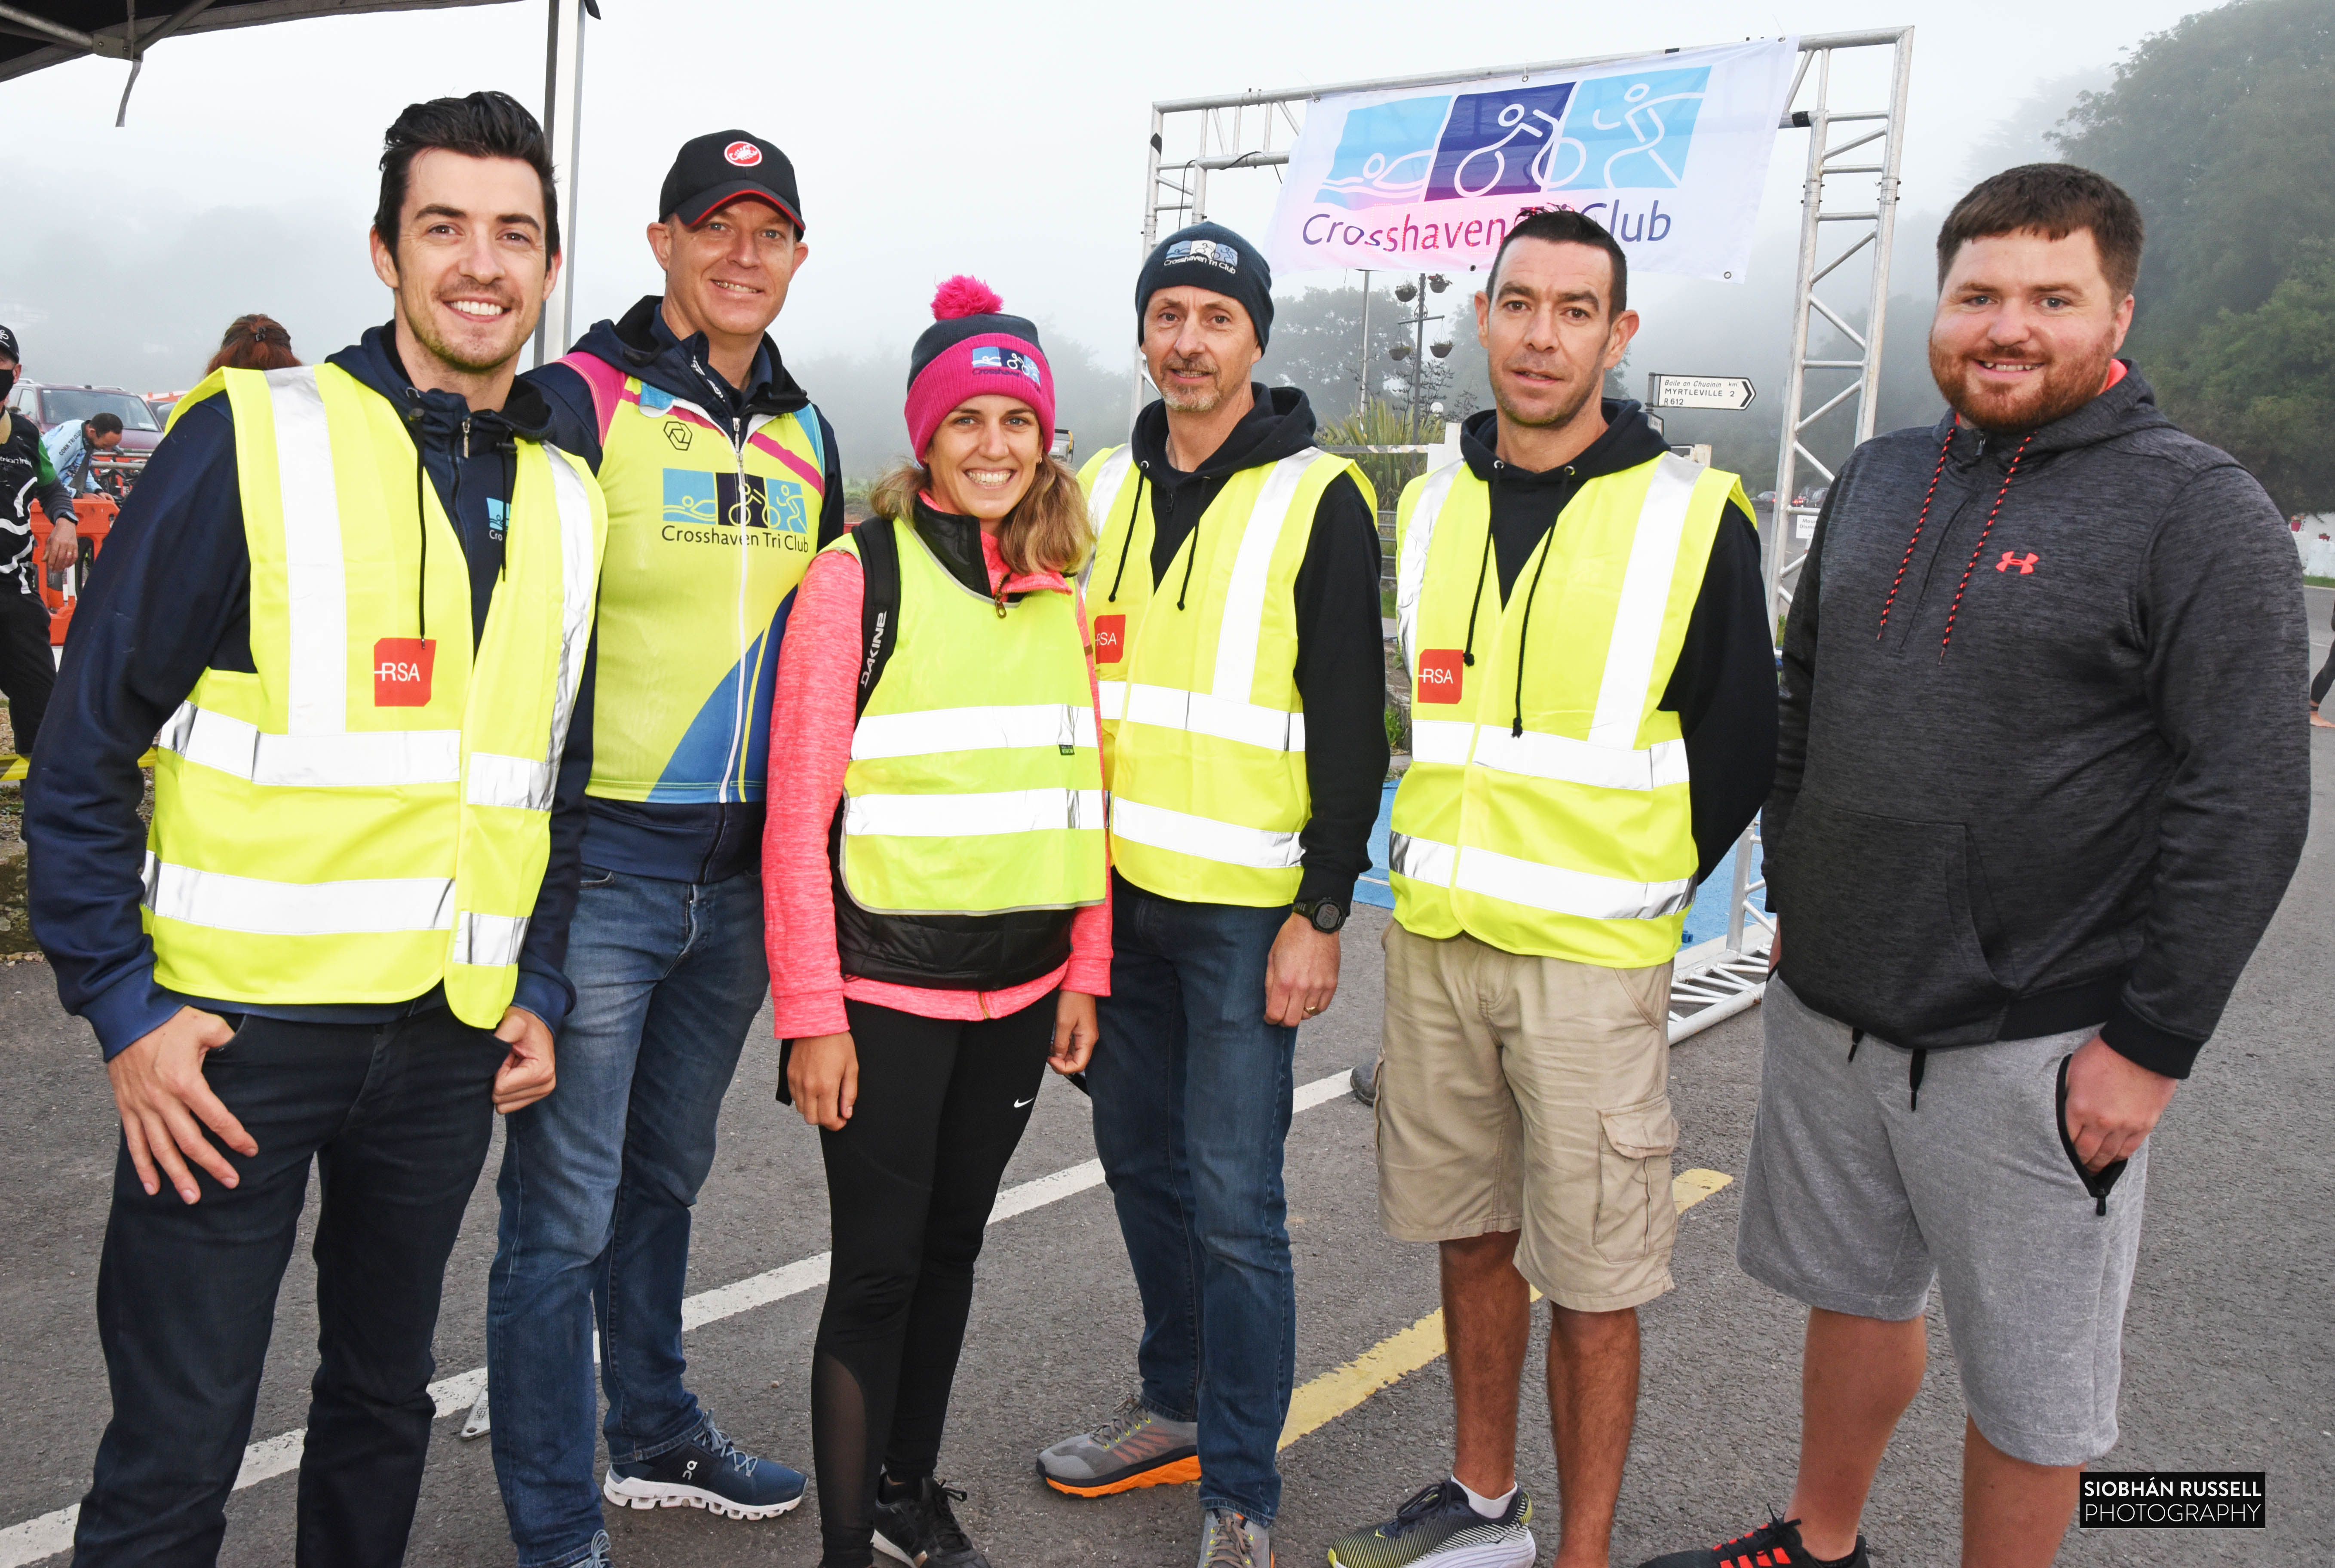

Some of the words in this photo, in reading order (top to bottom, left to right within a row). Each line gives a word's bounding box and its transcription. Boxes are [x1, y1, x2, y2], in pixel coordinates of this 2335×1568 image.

[1302, 213, 1507, 252] Crosshaven
[1163, 255, 1207, 266] Crosshaven
[1218, 262, 1236, 274] Club
[1665, 388, 1723, 397] MYRTLEVILLE
[58, 443, 71, 456] CORK
[661, 525, 759, 546] Crosshaven
[762, 532, 781, 549] Tri
[784, 535, 809, 553] Club
[1097, 632, 1117, 646] RSA
[860, 611, 887, 689] DAKINE
[381, 662, 420, 682] RSA
[1423, 668, 1454, 684] RSA
